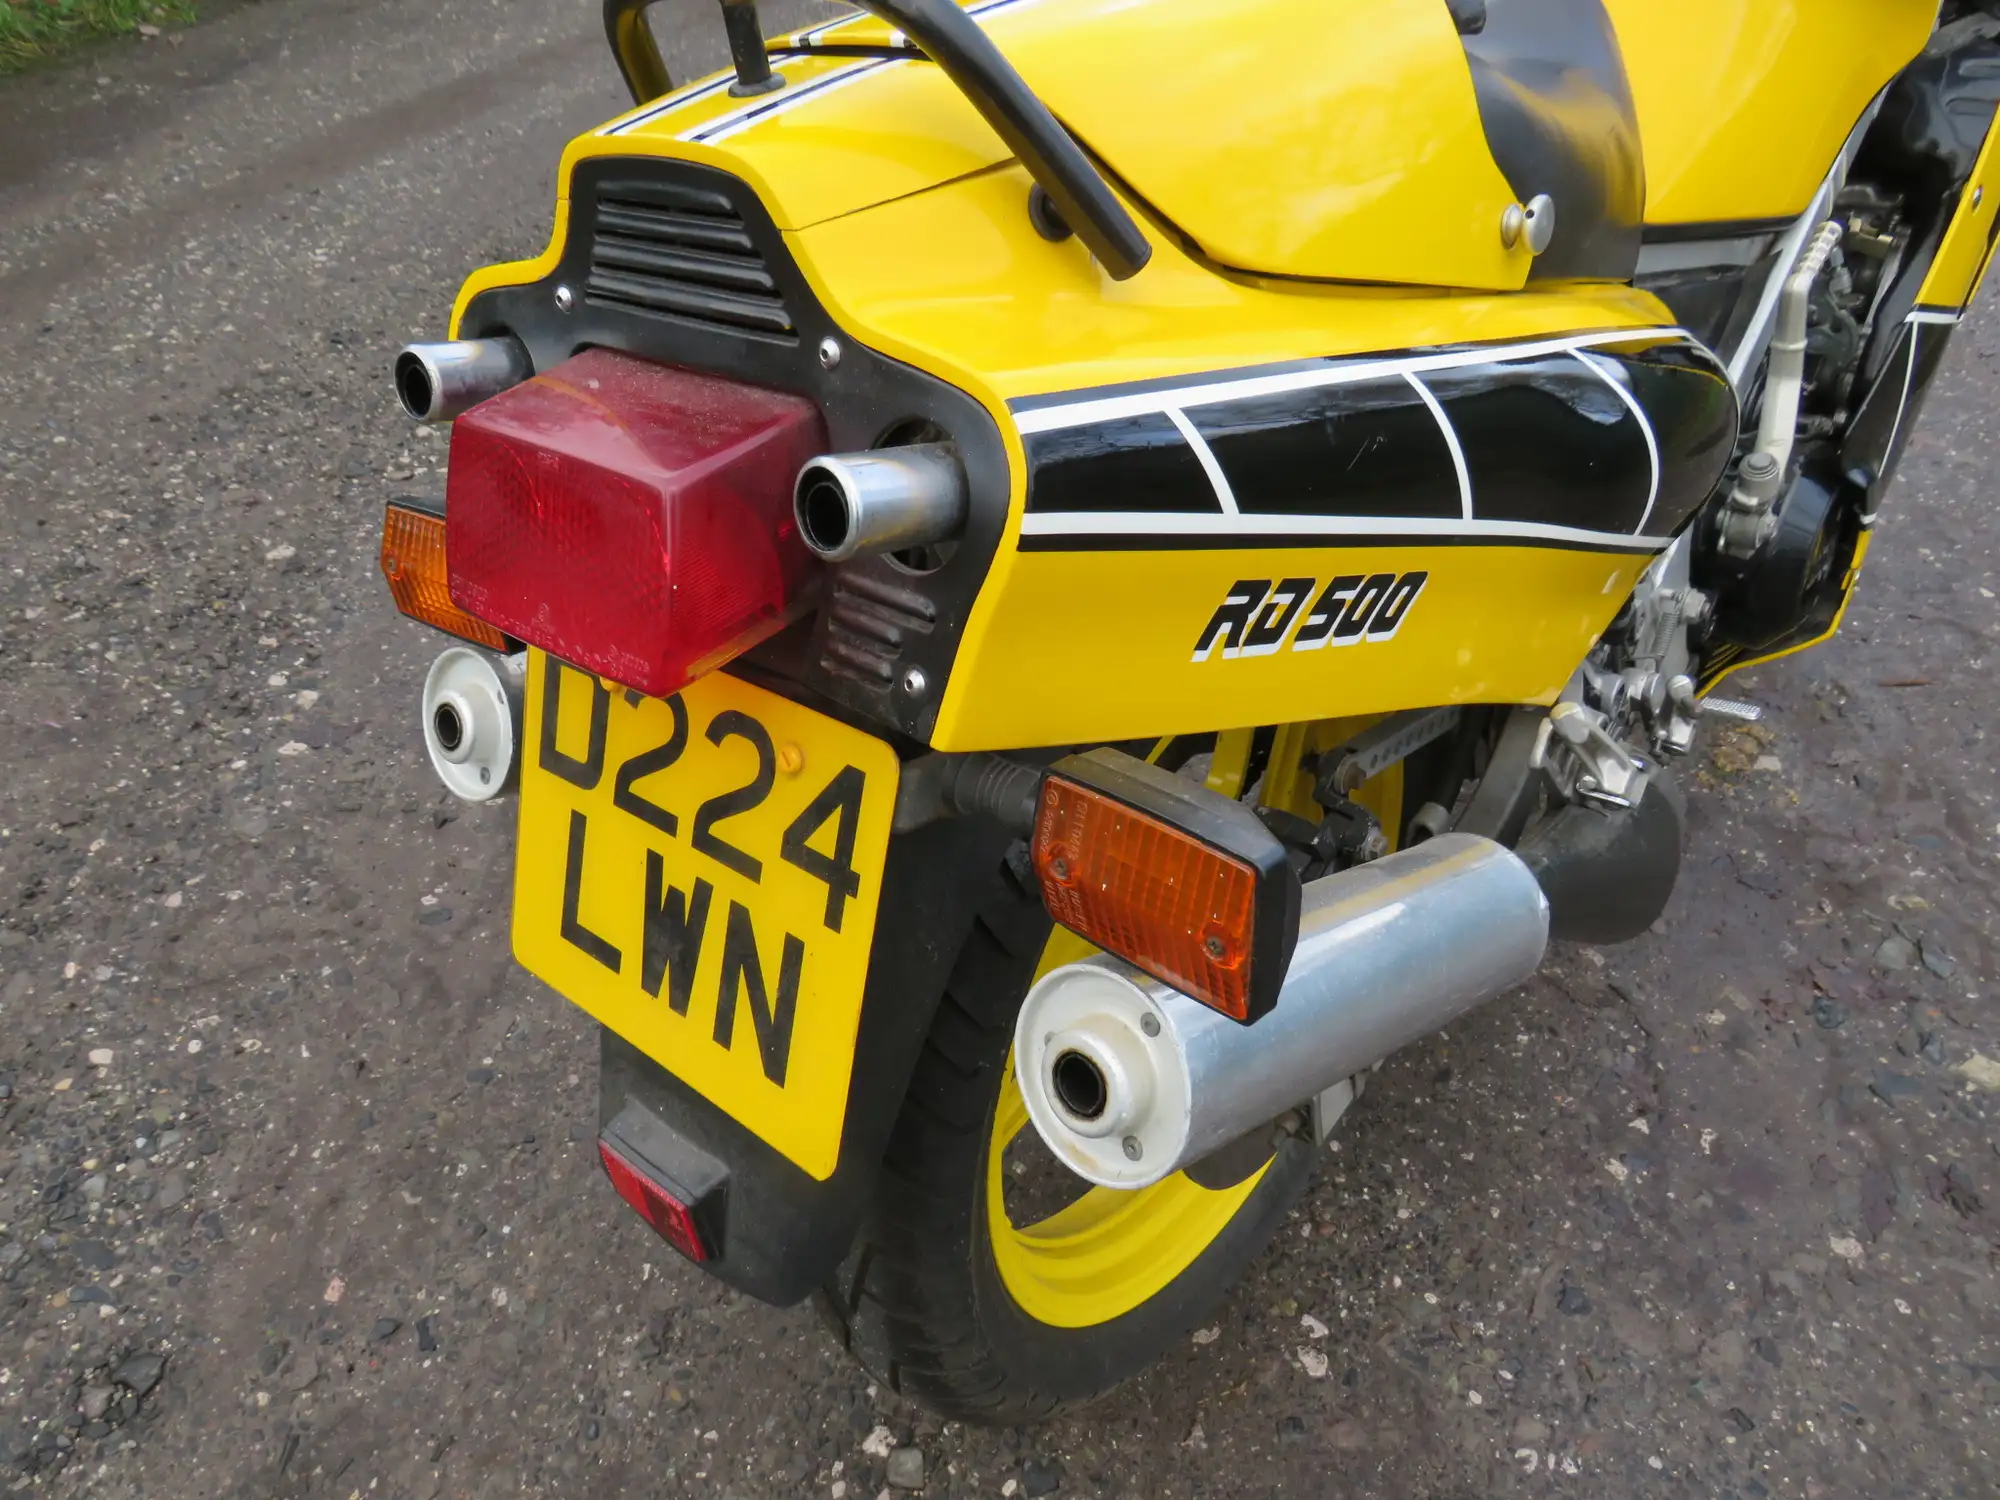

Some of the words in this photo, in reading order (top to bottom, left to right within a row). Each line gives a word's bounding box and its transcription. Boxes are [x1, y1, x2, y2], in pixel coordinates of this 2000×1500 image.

[1190, 577, 1317, 662] RD
[1292, 570, 1428, 652] 500
[538, 650, 867, 935] D224
[560, 808, 806, 1090] LWN
